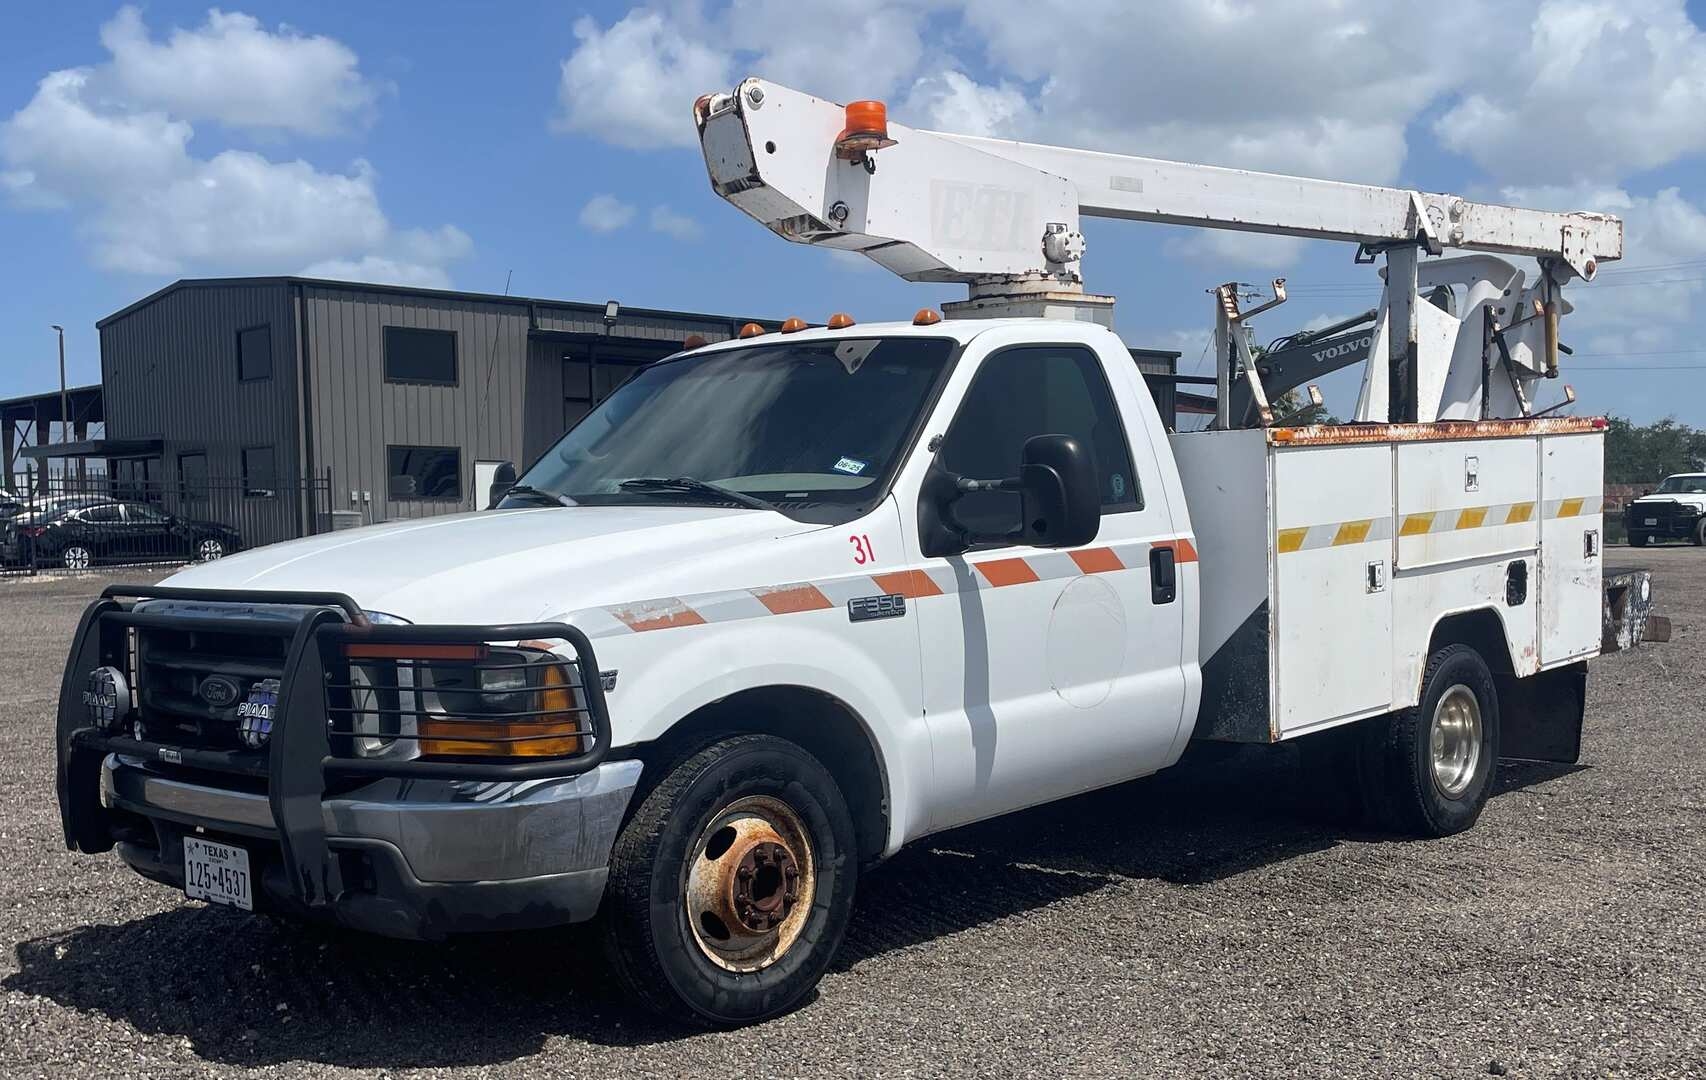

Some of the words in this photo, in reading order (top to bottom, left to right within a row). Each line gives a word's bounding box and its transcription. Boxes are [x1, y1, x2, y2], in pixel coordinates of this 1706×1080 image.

[1311, 336, 1371, 362] VOLVO
[850, 535, 875, 564] 31
[205, 684, 229, 701] Ford
[237, 702, 270, 718] PIAA
[203, 845, 229, 860] TEXAS
